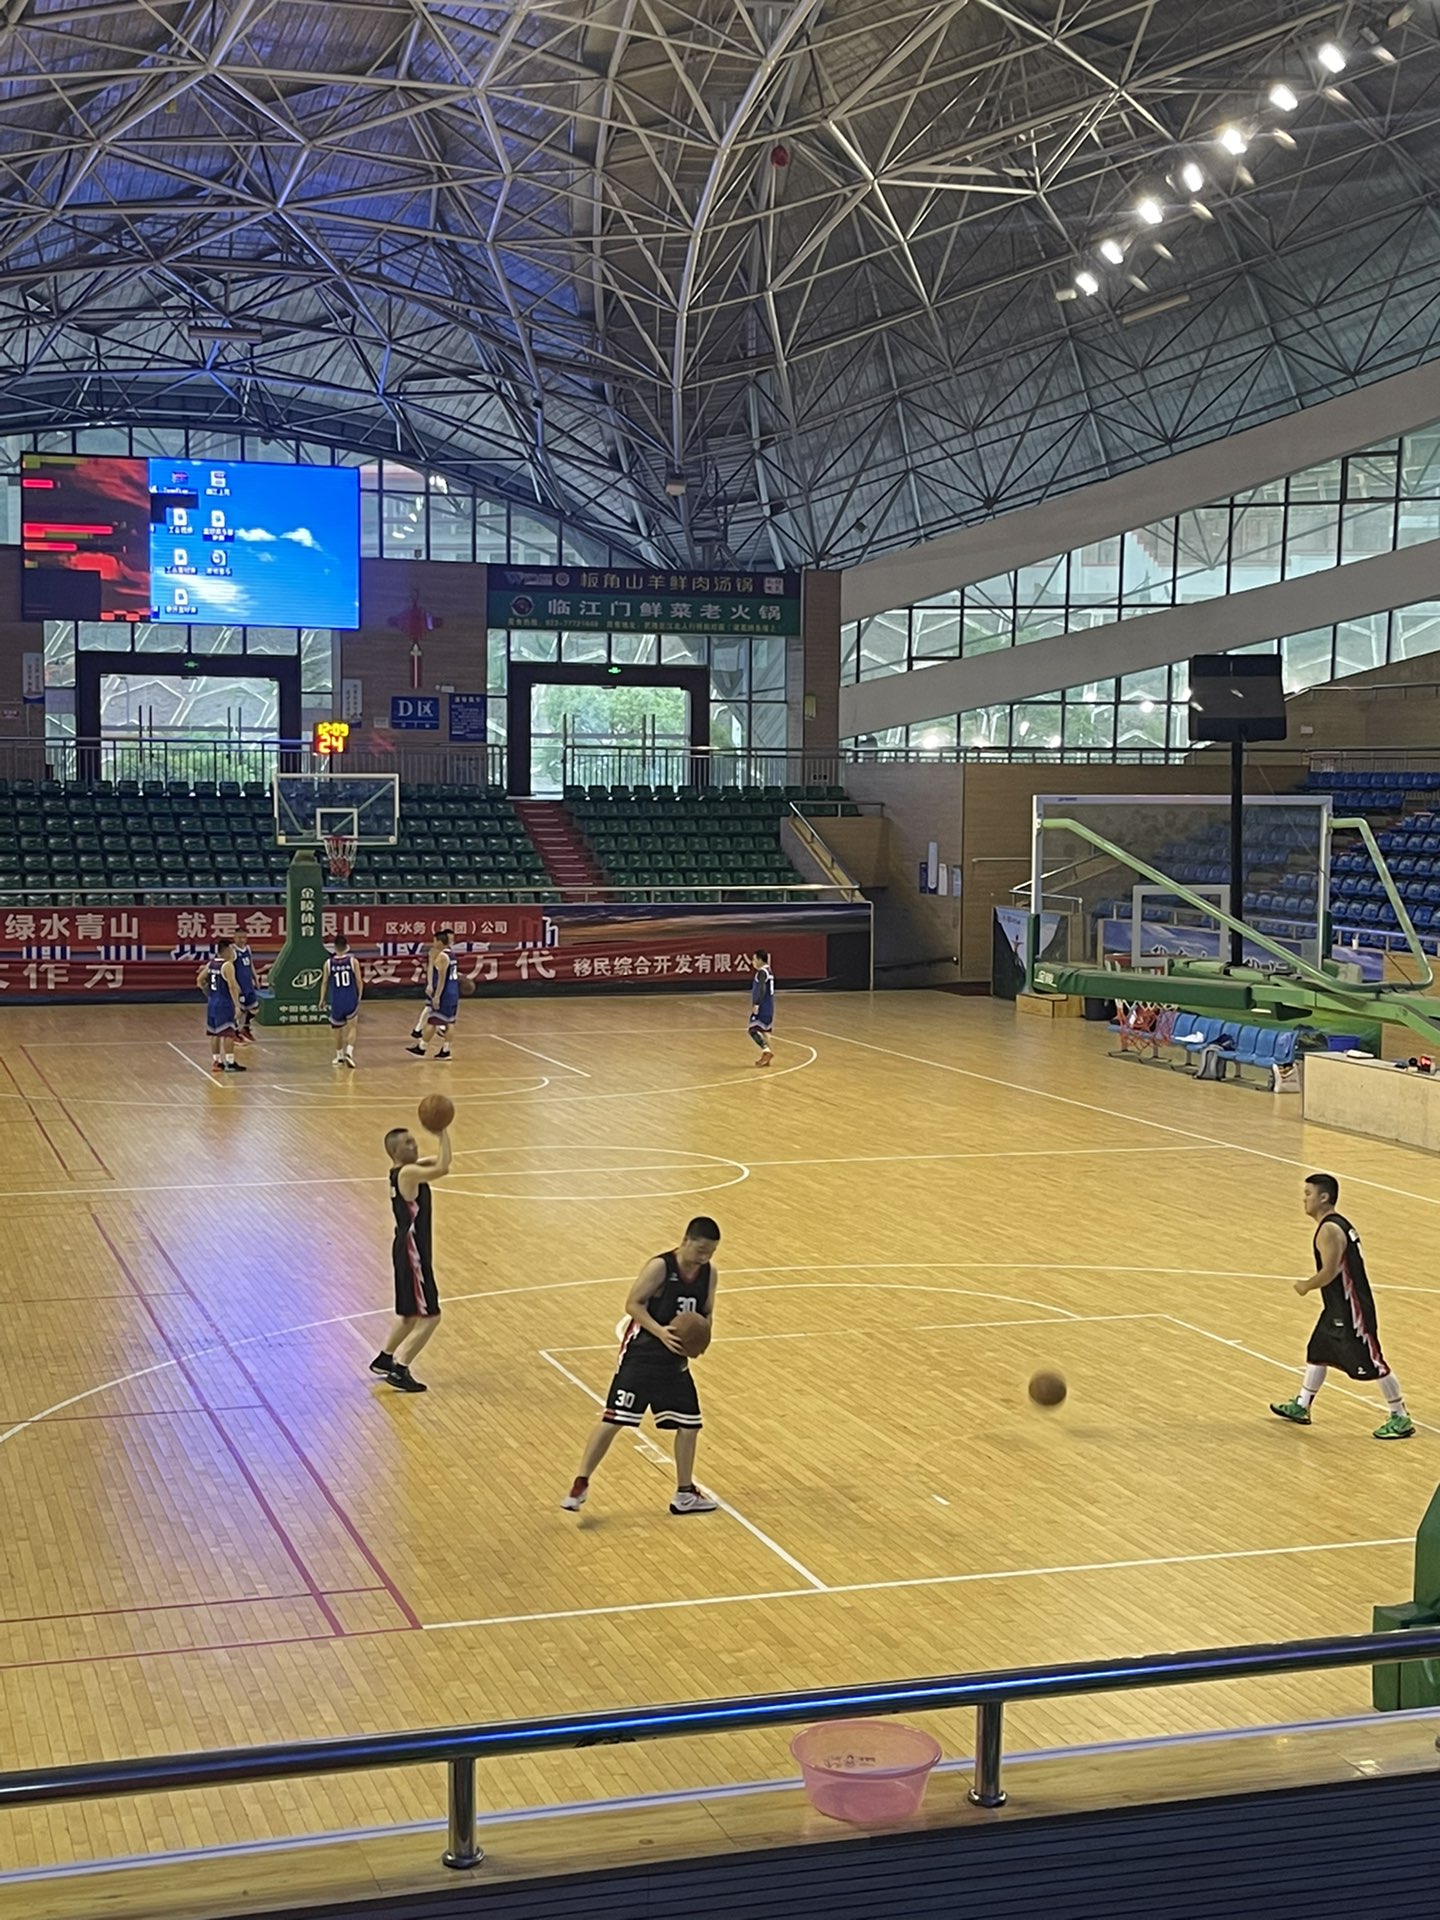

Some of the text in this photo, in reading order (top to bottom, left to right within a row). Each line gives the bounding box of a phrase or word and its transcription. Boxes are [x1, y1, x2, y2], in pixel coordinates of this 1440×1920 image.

[580, 572, 753, 592] 板角山羊鲜肉汤锅
[548, 599, 781, 620] 临江门鲜菜老火锅
[318, 722, 349, 737] 12:09
[319, 736, 344, 753] 24
[4, 913, 138, 940] 绿水青山
[573, 953, 771, 977] 移民综合开发有限公
[334, 970, 350, 988] 10
[676, 1296, 698, 1313] 30
[615, 1389, 636, 1410] 30
